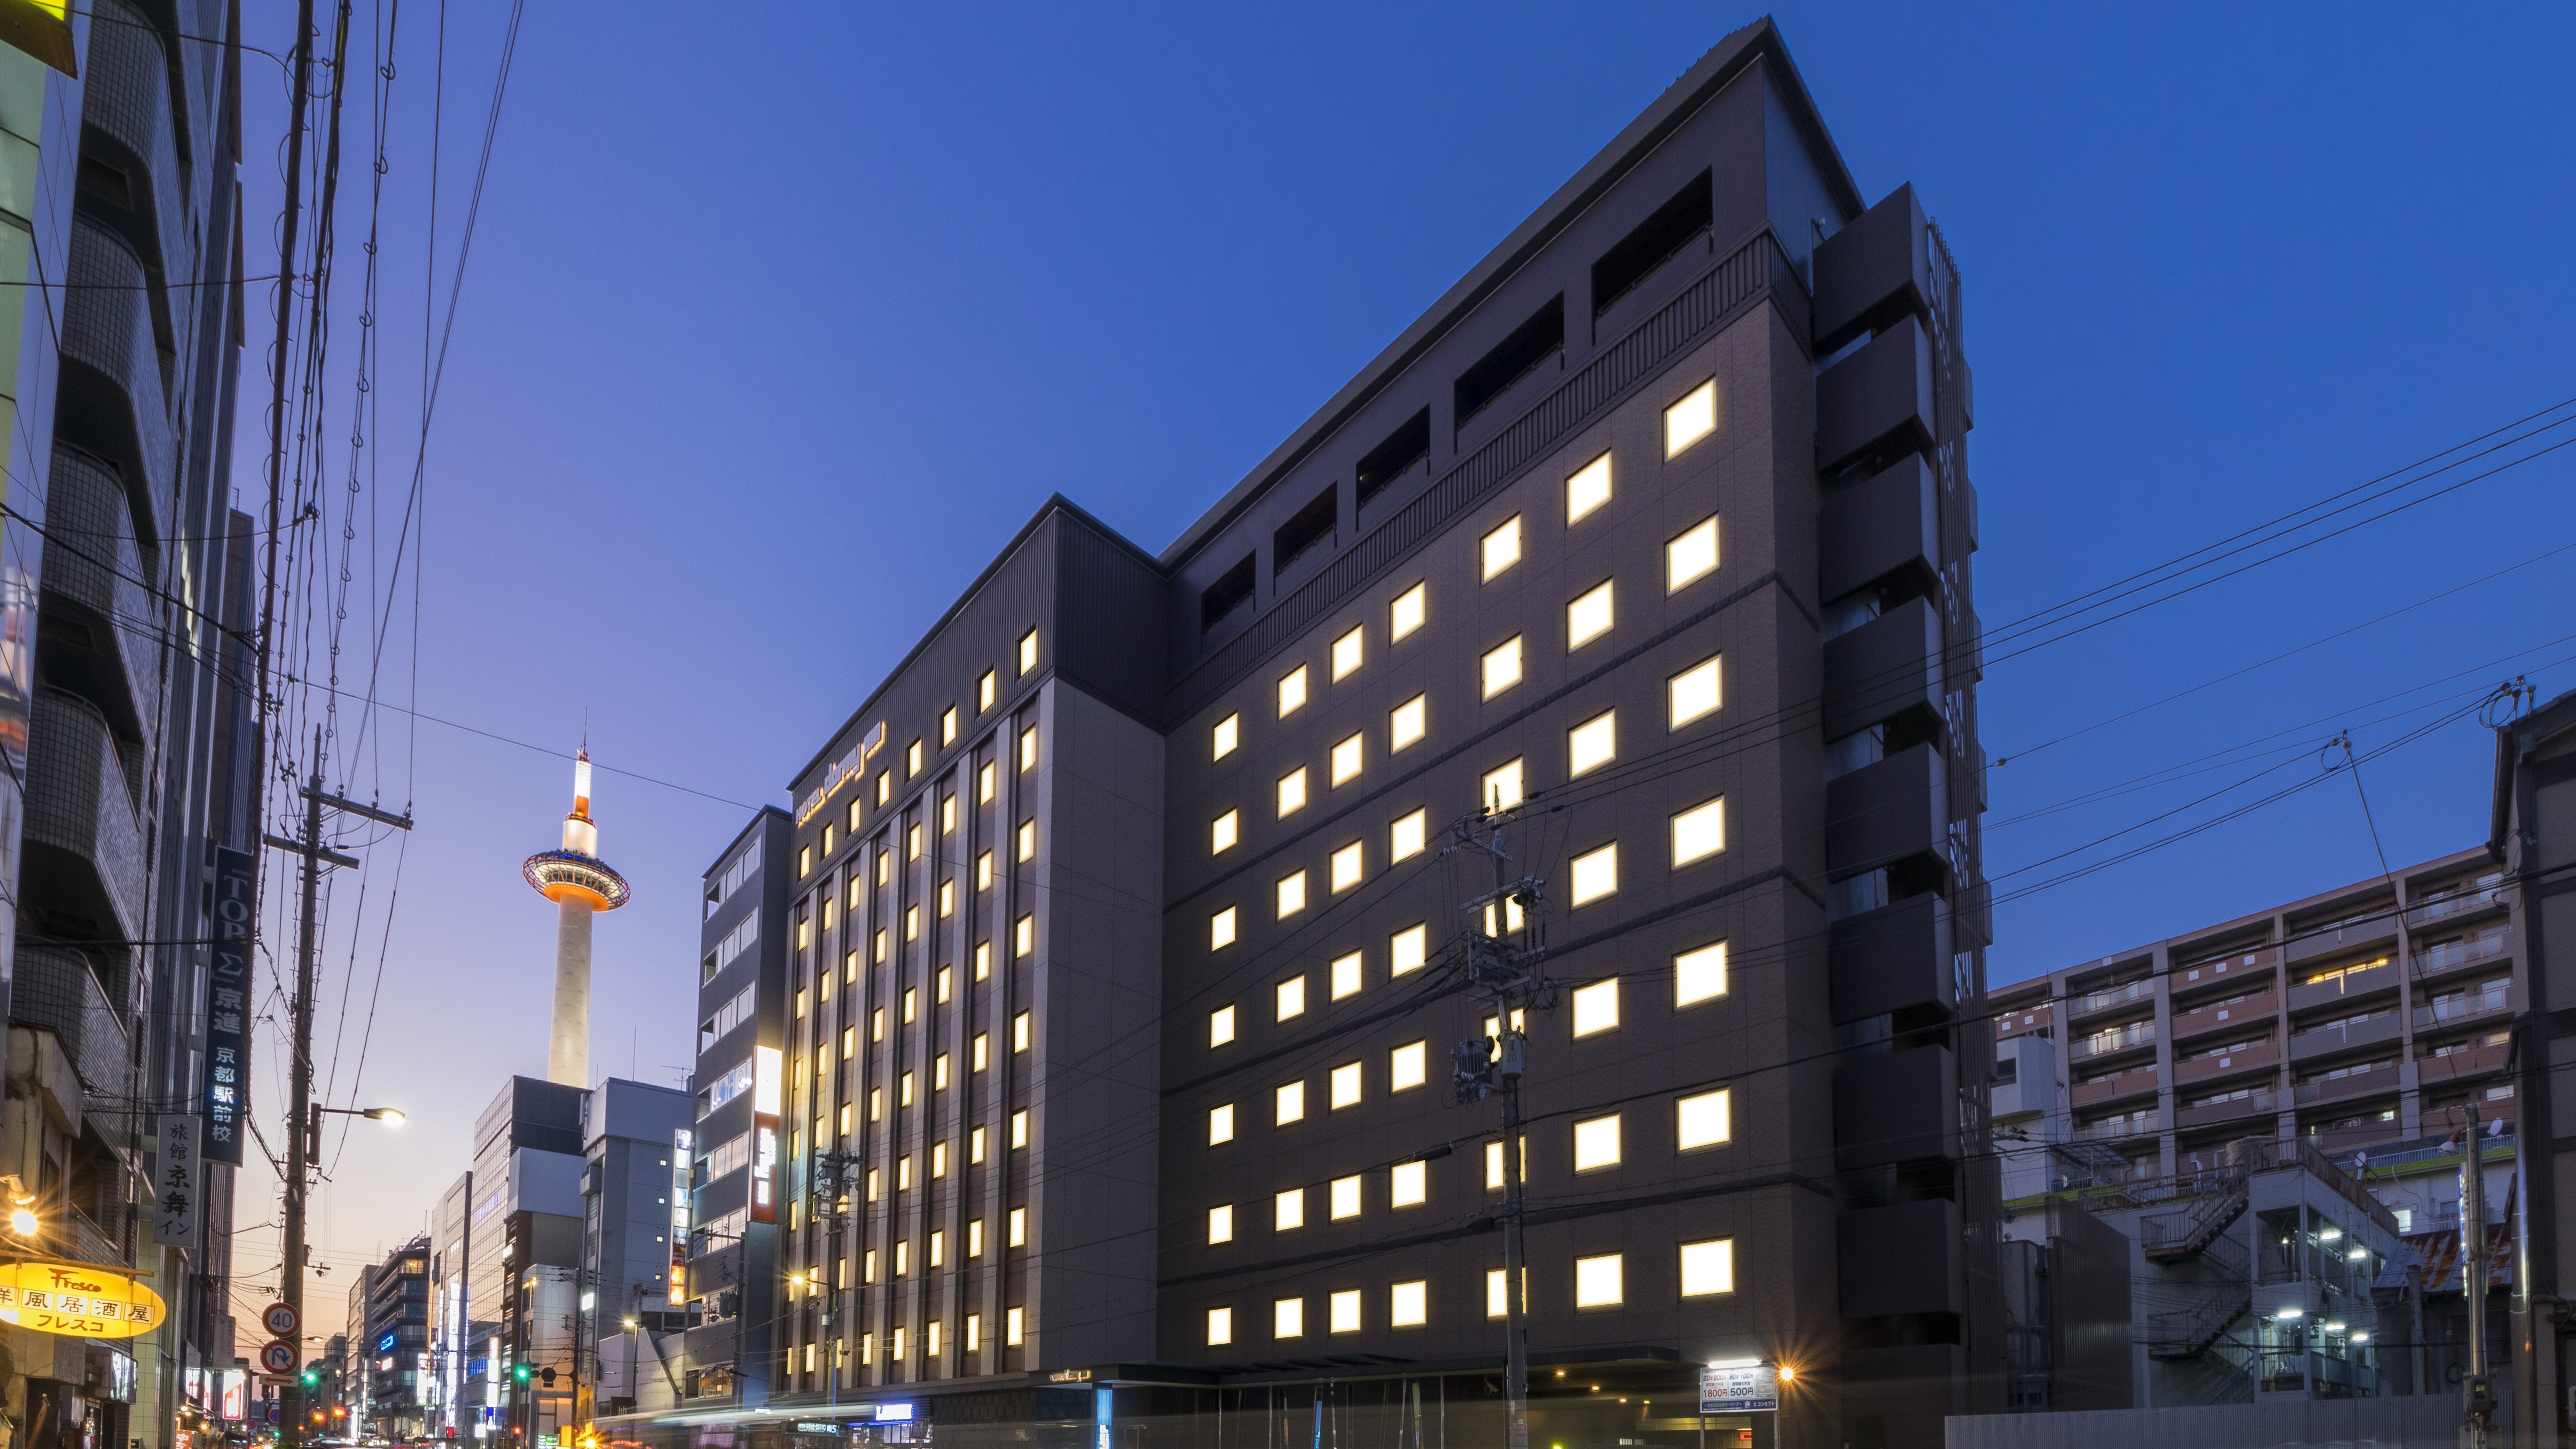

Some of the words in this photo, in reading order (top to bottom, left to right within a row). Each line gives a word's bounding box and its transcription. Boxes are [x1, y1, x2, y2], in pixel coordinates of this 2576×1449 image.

[212, 1046, 235, 1143] 京都駅前校
[48, 1268, 102, 1293] Fresco
[37, 1314, 104, 1332] フレスコ
[271, 1312, 292, 1328] 40
[1703, 1389, 1727, 1398] 1800円
[1730, 1387, 1753, 1396] 500円
